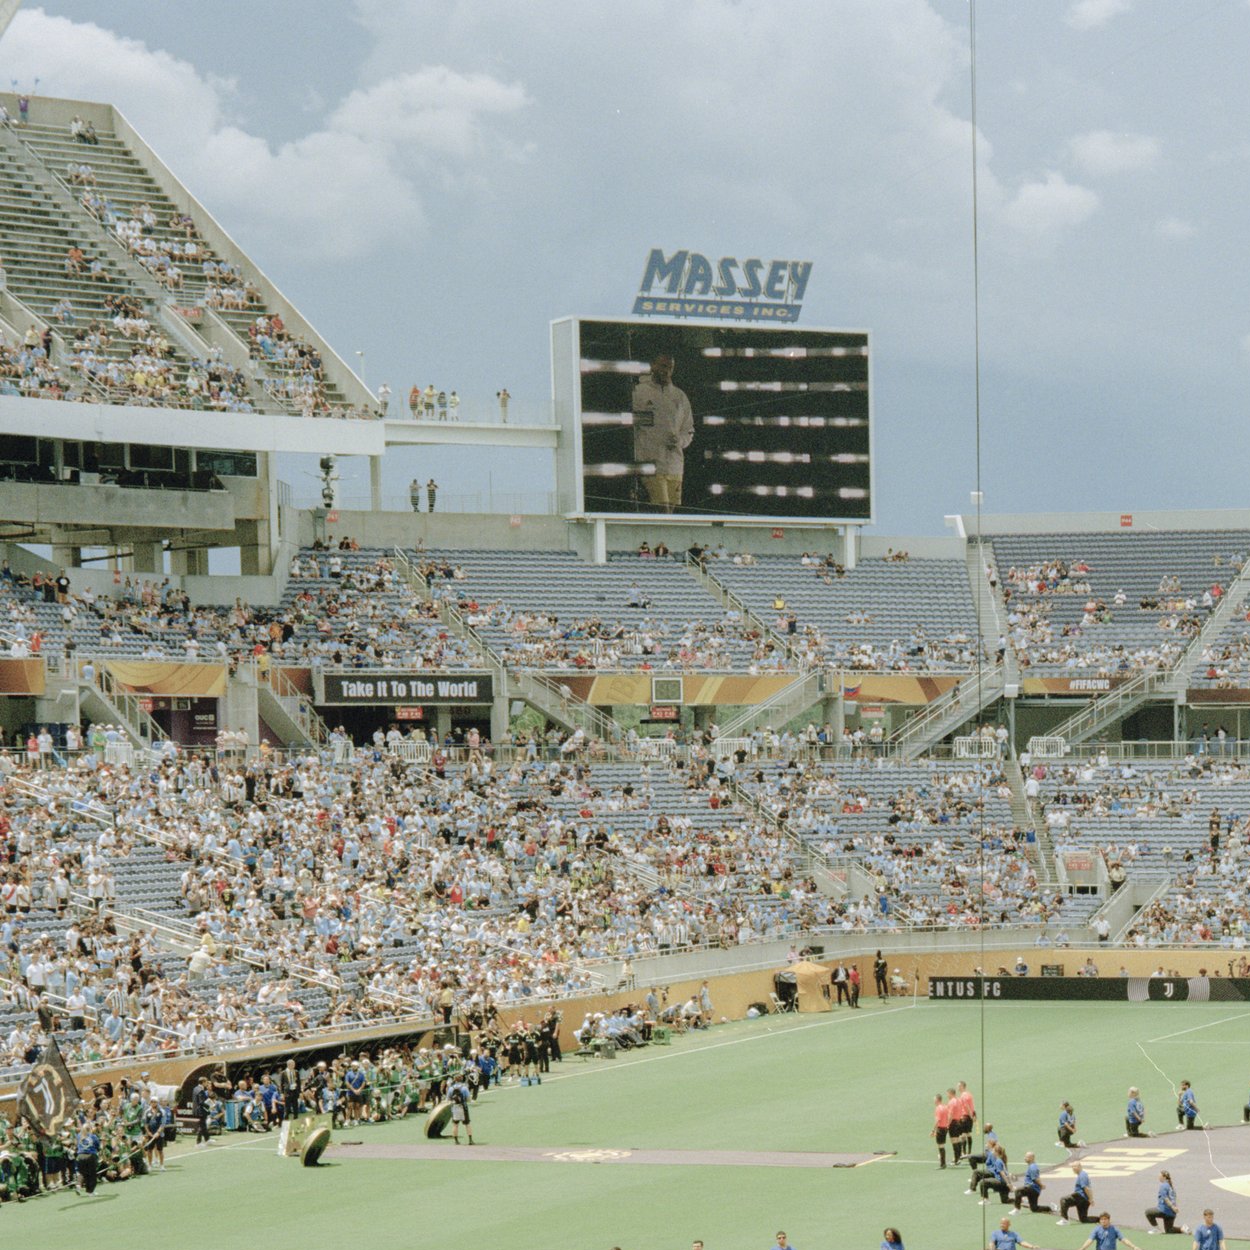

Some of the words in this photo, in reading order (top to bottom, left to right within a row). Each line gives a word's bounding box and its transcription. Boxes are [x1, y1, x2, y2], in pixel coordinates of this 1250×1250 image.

[640, 248, 813, 301] MASSEY
[641, 301, 745, 315] SERVICES
[752, 307, 792, 318] INC.
[341, 680, 374, 697] Take
[377, 680, 388, 697] It
[390, 680, 407, 697] To
[410, 680, 435, 697] The
[437, 681, 477, 697] World
[1069, 679, 1110, 690] #FIFACWC
[983, 982, 1001, 997] FC
